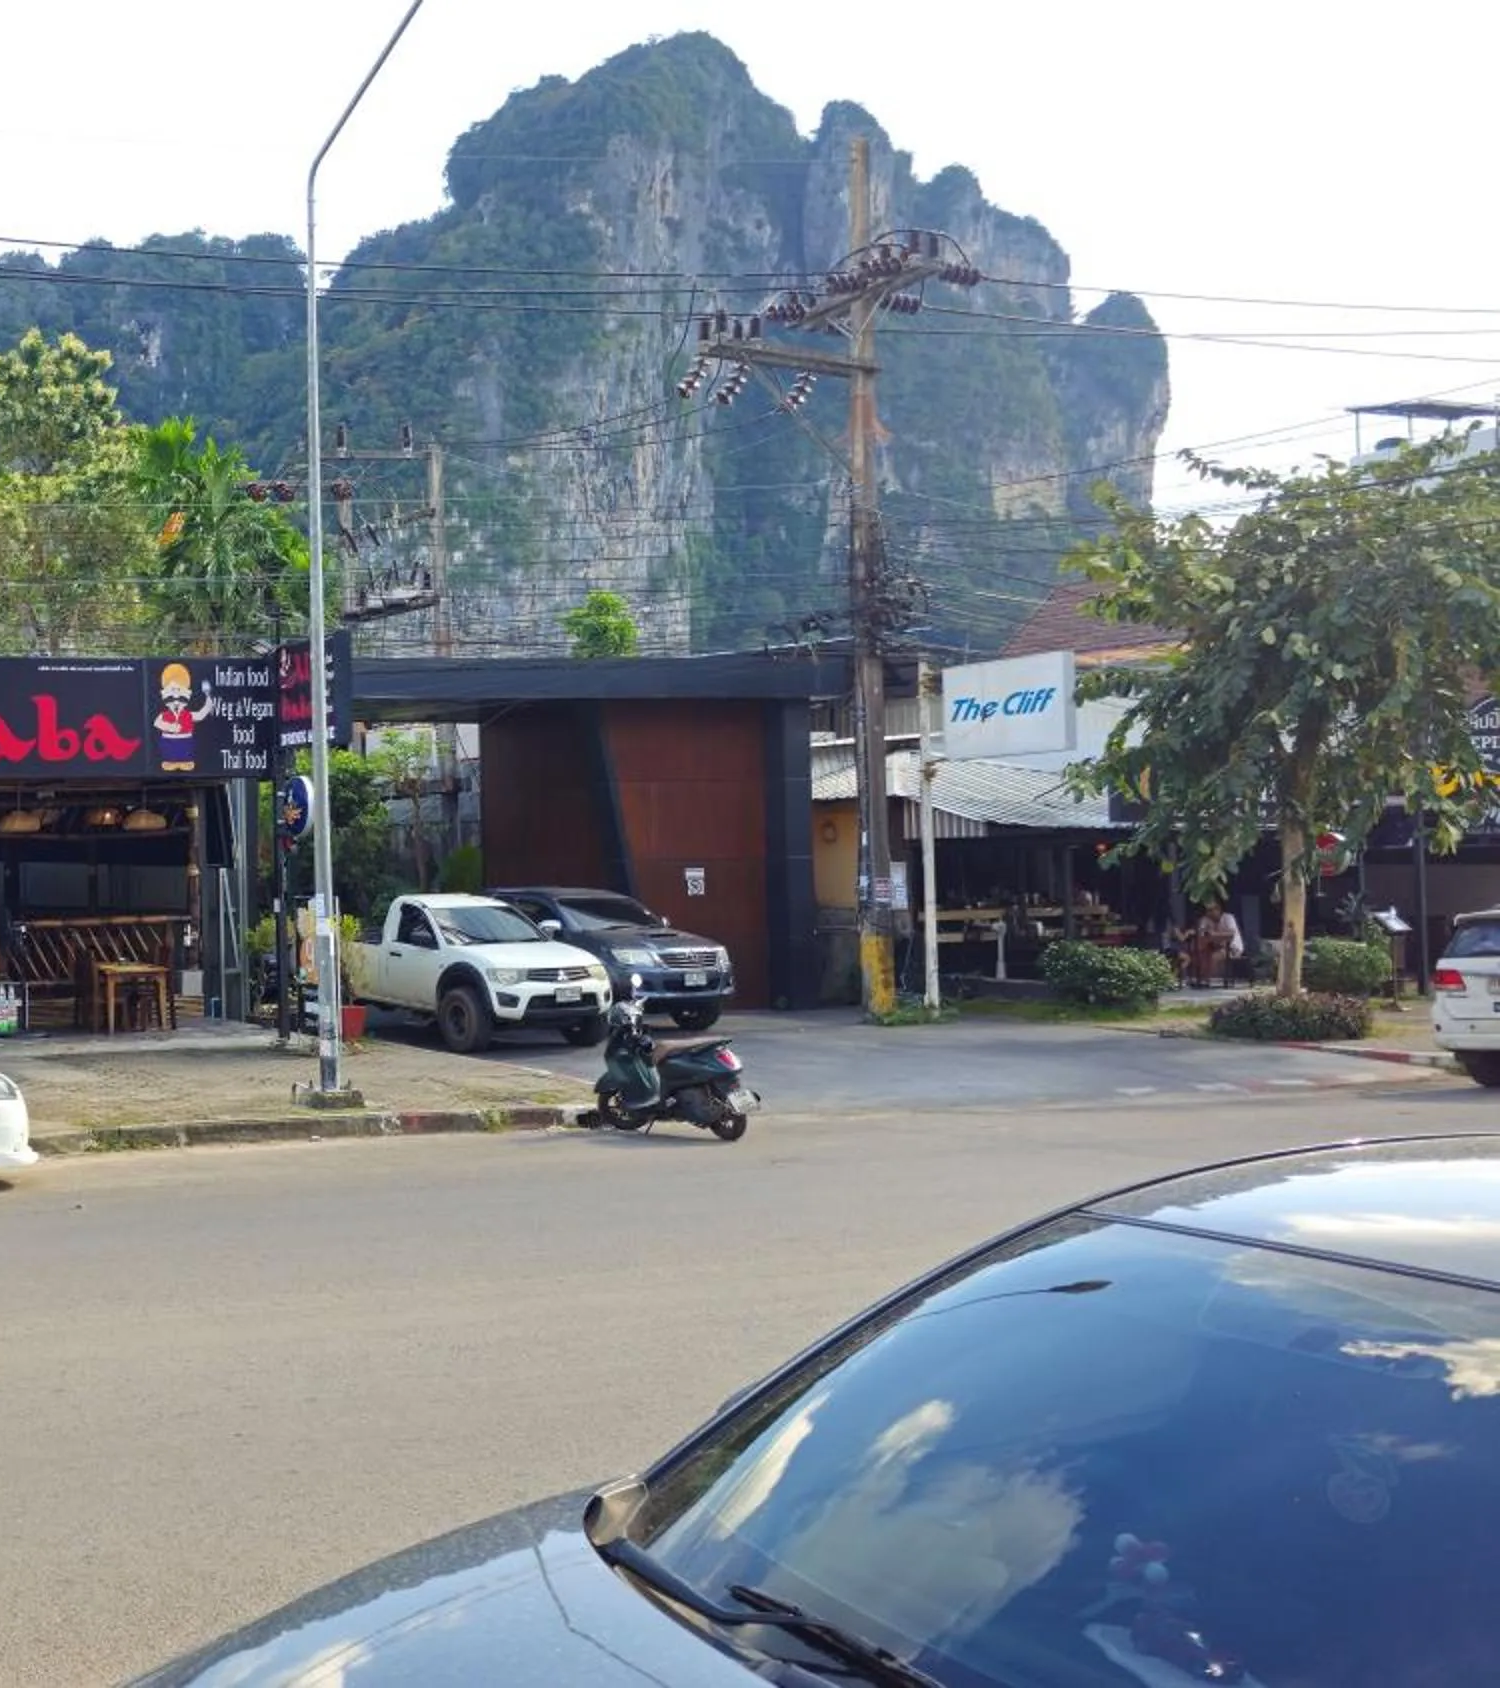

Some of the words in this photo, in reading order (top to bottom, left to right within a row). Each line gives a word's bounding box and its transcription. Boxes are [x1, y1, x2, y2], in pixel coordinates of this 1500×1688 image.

[215, 665, 245, 687] Indian
[247, 666, 269, 687] food
[950, 697, 999, 722] The
[1003, 687, 1057, 717] Cliff
[233, 724, 255, 745] food
[221, 750, 243, 769] Thai
[245, 750, 267, 769] food
